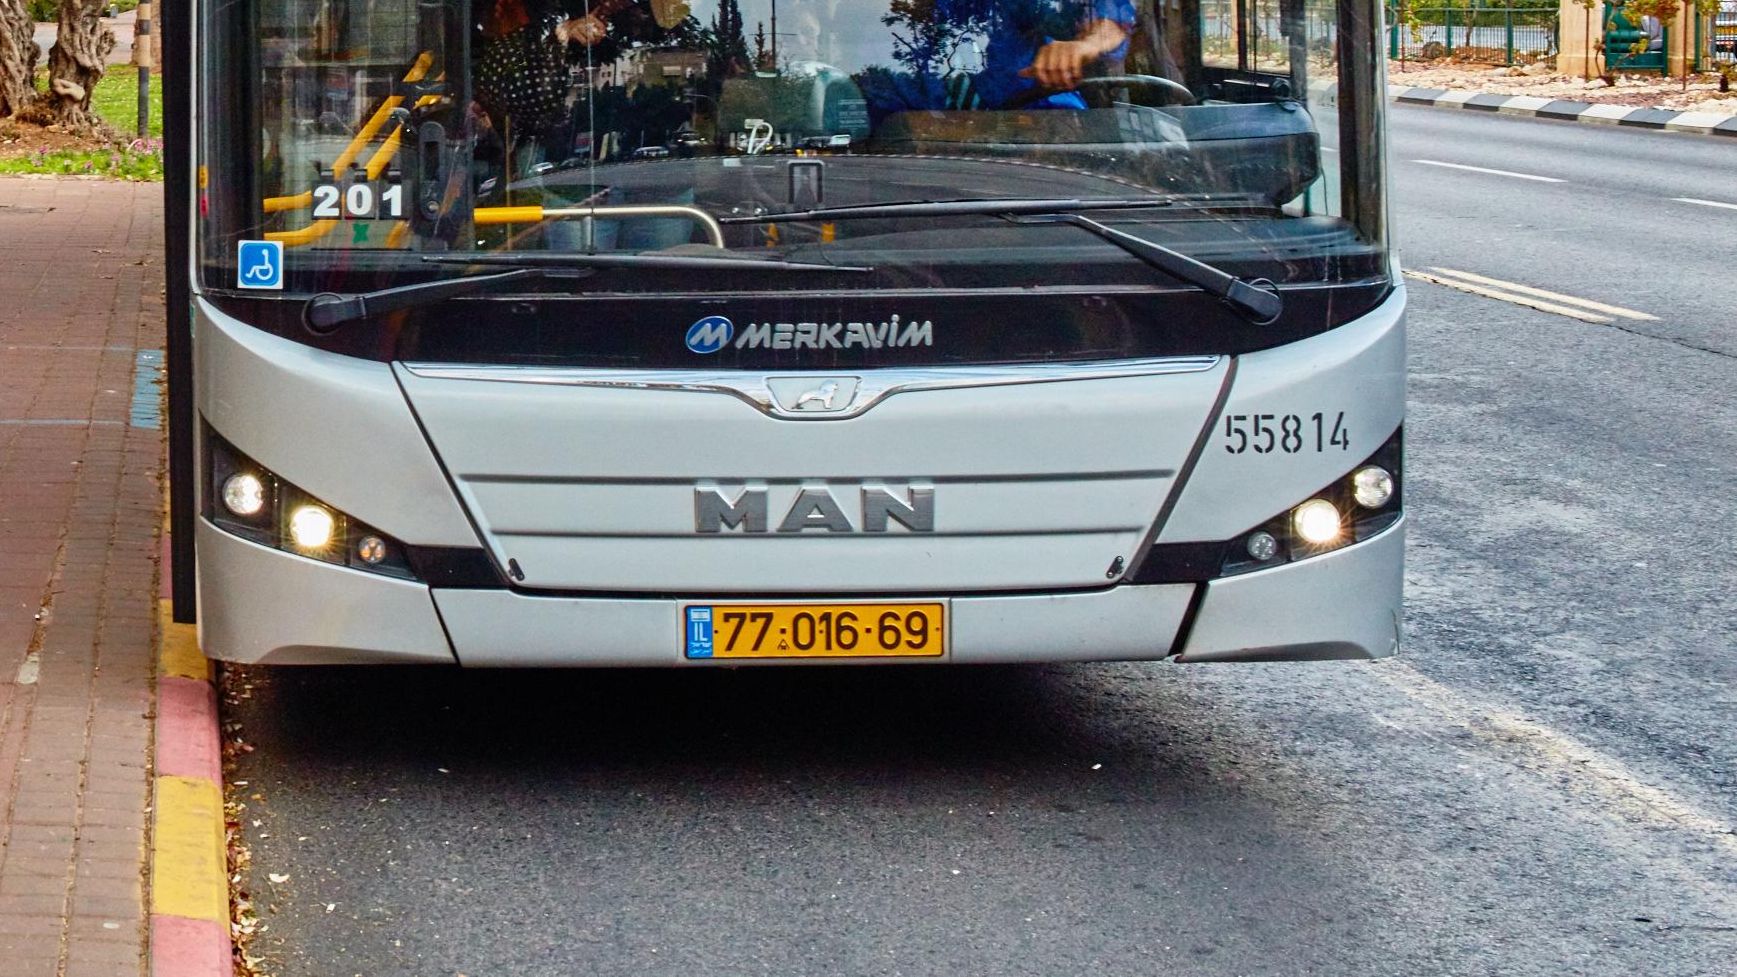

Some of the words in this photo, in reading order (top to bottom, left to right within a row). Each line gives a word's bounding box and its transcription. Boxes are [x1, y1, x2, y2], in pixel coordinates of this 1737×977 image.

[313, 184, 402, 217] 201
[1225, 411, 1350, 455] 55814
[694, 484, 935, 533] MAN
